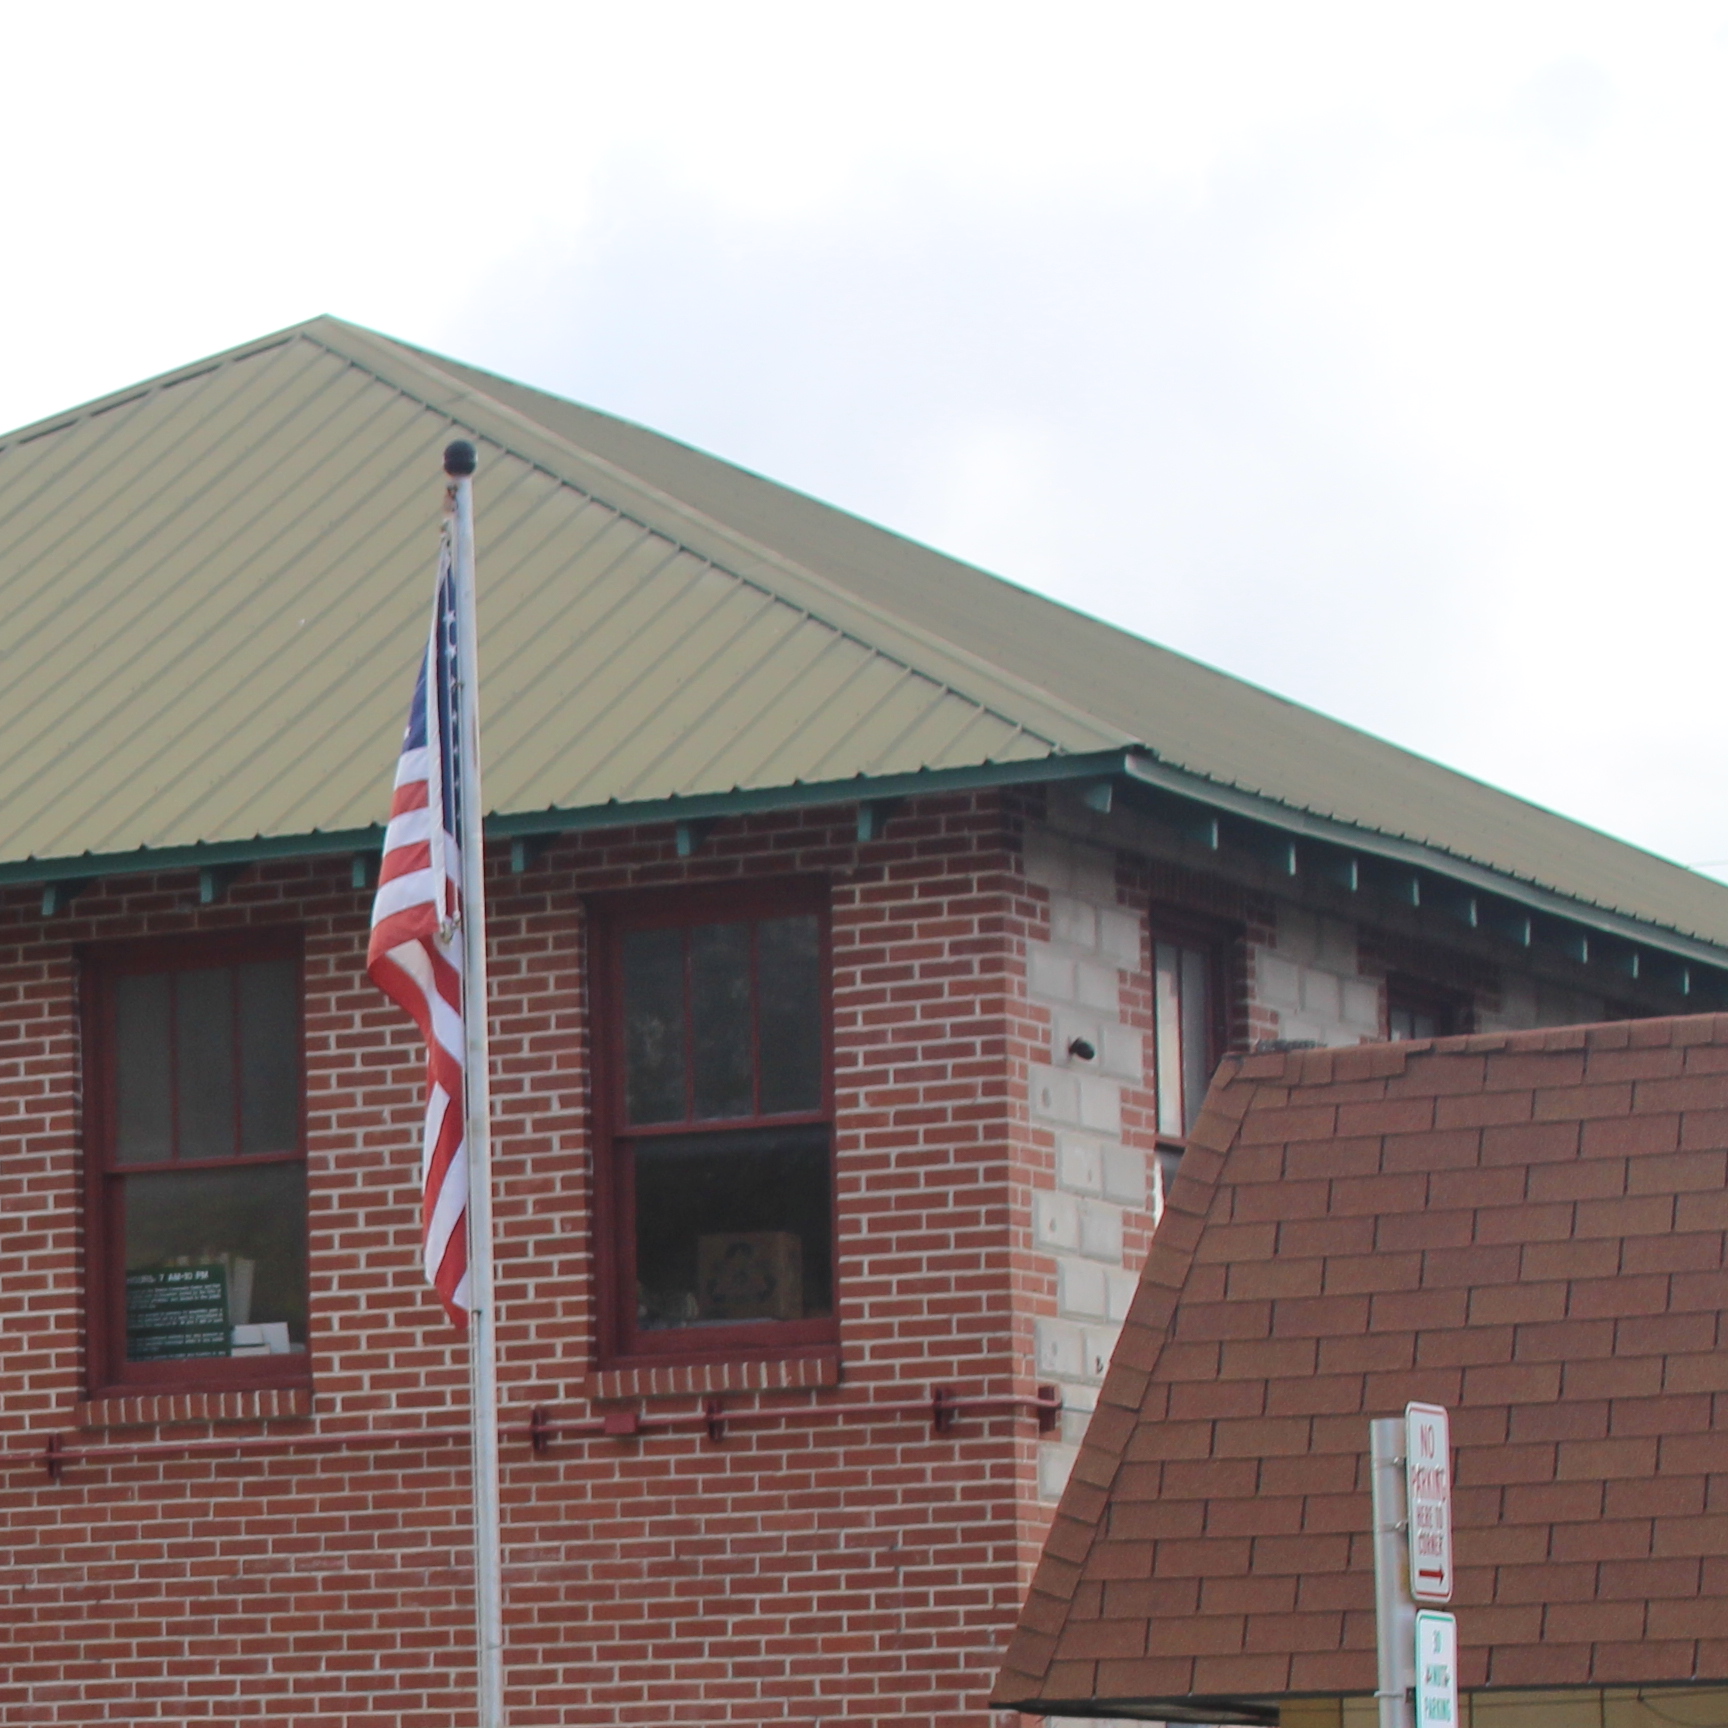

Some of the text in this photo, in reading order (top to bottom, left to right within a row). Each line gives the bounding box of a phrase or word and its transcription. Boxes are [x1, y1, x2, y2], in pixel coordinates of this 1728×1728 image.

[1420, 1424, 1435, 1459] NO
[1412, 1464, 1446, 1502] PARKING
[1417, 1505, 1443, 1530] HERE TO
[1417, 1530, 1443, 1556] CORNER
[1424, 1696, 1451, 1722] PARKING
